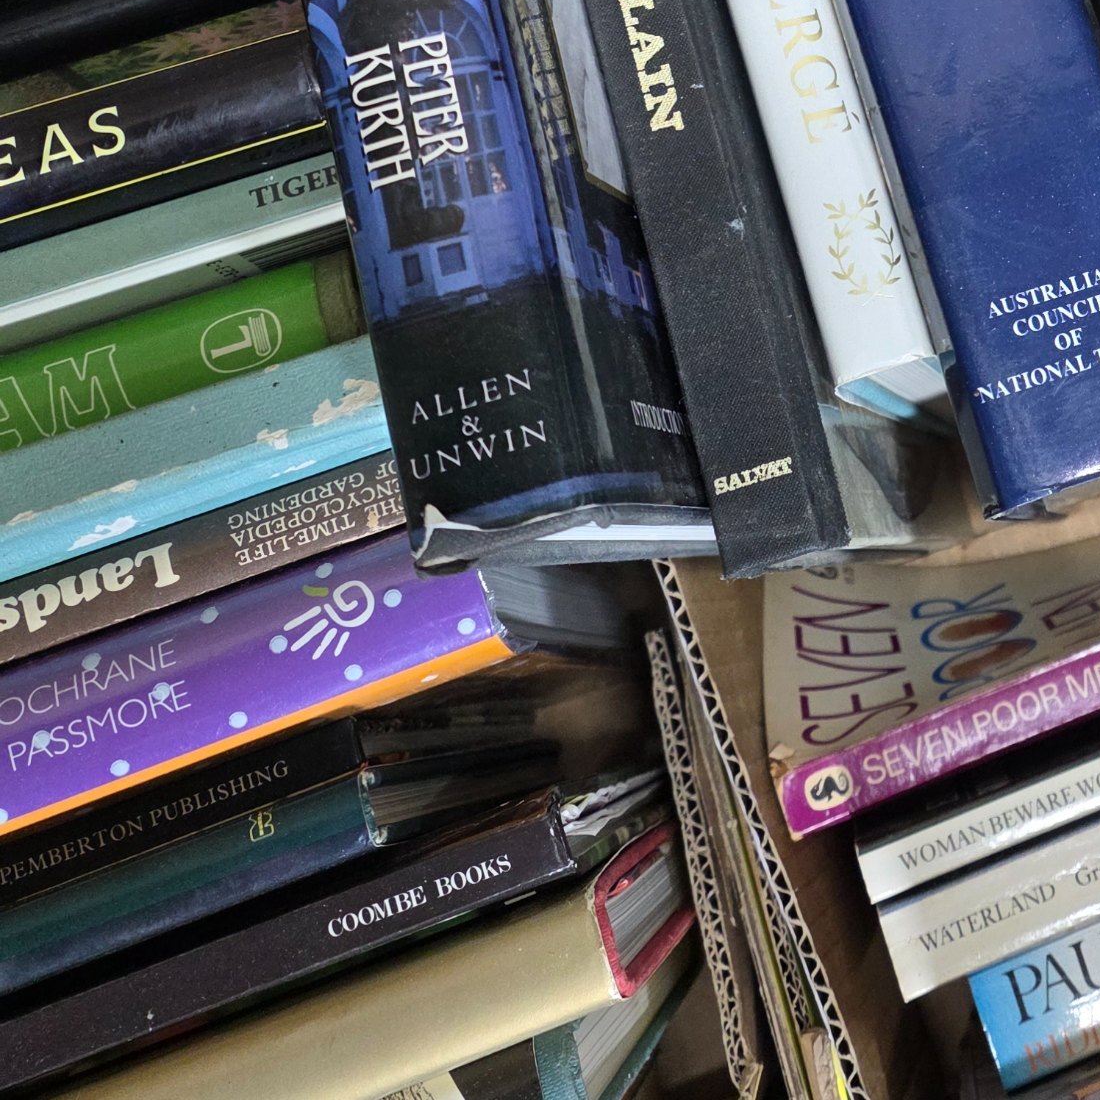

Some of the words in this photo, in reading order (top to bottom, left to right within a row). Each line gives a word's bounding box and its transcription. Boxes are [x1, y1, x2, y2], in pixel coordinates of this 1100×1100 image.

[345, 43, 416, 191] KURTH
[398, 31, 469, 167] PETER
[0, 105, 126, 188] EAS
[248, 165, 340, 208] TIGER
[976, 348, 1092, 404] NATIONAL
[1054, 327, 1084, 351] OF
[0, 344, 136, 448] AM
[410, 367, 532, 425] ALLEN
[461, 413, 483, 435] &
[409, 419, 547, 480] UNWIN
[714, 456, 793, 495] SALVAT
[227, 472, 365, 530] GARDENING
[234, 513, 356, 566] TIME-LIFE
[0, 542, 181, 633] Lands
[0, 639, 180, 727] OCHRANE
[7, 680, 193, 771] PASSMORE
[862, 721, 973, 786] SEVEN
[971, 682, 1063, 739] POOR
[0, 812, 145, 886] PEMBERTON
[147, 759, 291, 830] PUBLISHING
[897, 820, 988, 871] WOMAN
[988, 786, 1076, 837] BEWARE
[326, 884, 427, 939] COOMBE
[434, 853, 512, 896] BOOKS
[918, 881, 1057, 952] WATERLAND
